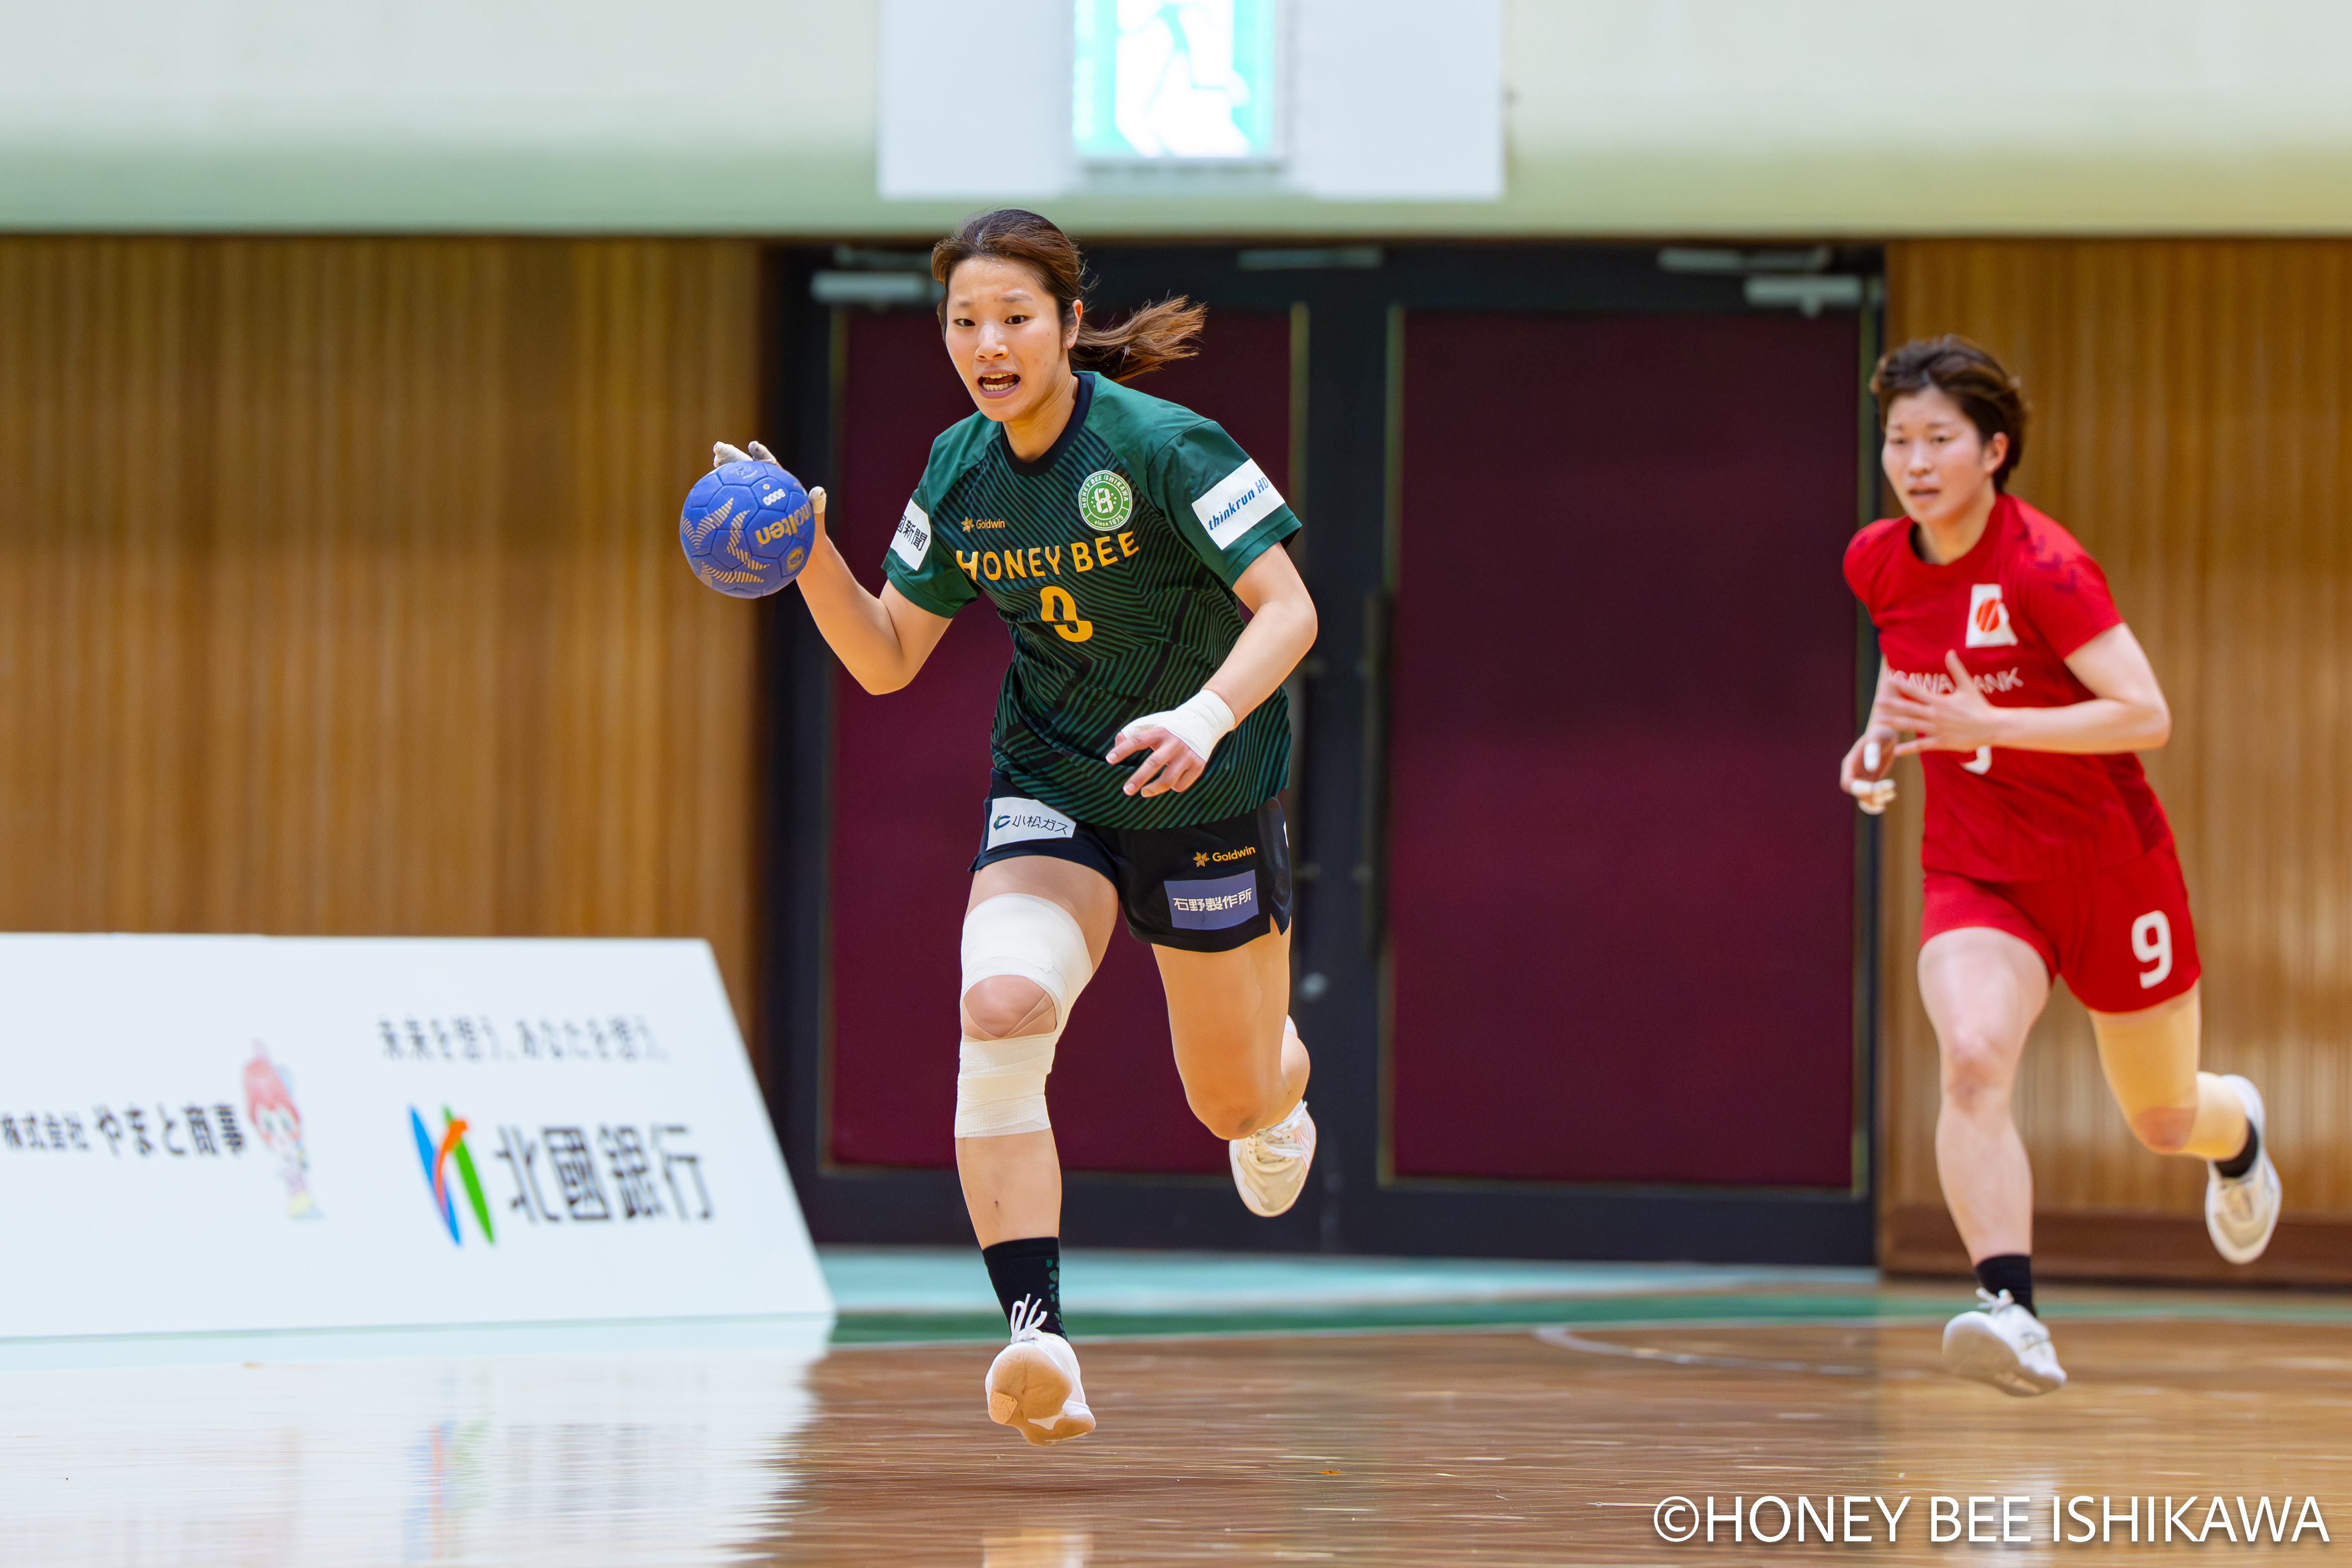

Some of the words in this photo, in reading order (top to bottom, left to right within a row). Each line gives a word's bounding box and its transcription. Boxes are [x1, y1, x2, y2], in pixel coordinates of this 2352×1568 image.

[1082, 482, 1091, 508] HONEY
[1090, 475, 1102, 484] BEE
[1103, 474, 1129, 502] ISHIKAWA
[1208, 489, 1255, 531] thinkrun
[1254, 476, 1269, 494] HD
[755, 501, 812, 545] molten
[975, 518, 1006, 529] Goldwin
[956, 545, 1060, 581] HONEY
[1070, 531, 1139, 572] BEE
[1973, 666, 2024, 694] ANK
[1012, 814, 1068, 836] 小松ガス
[1212, 846, 1256, 862] Goldwin
[1172, 888, 1252, 912] 石野製作所
[2131, 910, 2173, 990] 9
[494, 1124, 714, 1223] 北國銀行
